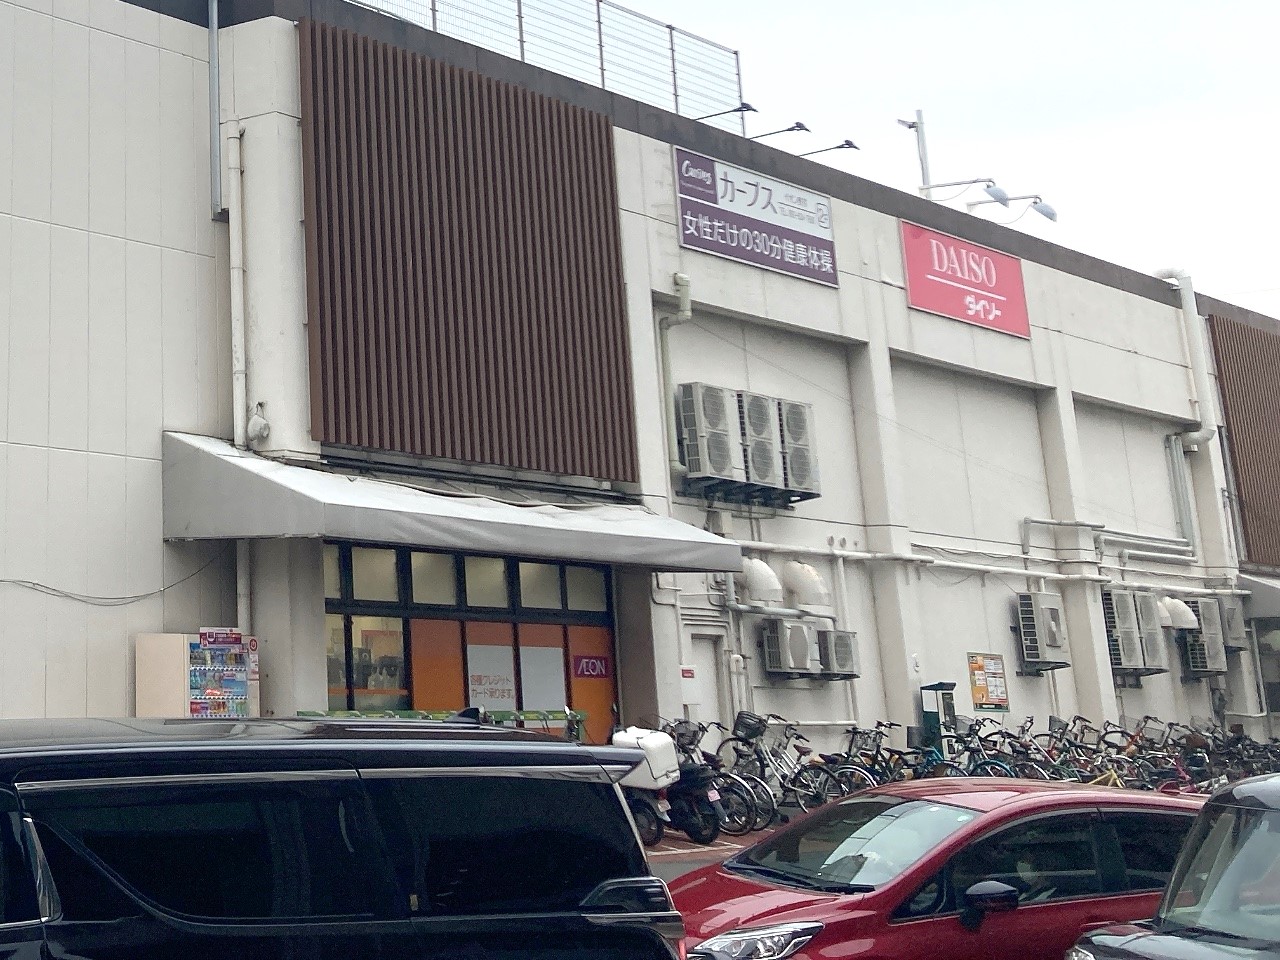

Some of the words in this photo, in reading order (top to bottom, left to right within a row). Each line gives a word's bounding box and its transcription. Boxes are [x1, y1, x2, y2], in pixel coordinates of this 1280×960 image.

[682, 210, 834, 274] 女性だけの30分健康体操
[930, 239, 998, 289] DAISO
[965, 294, 1002, 321] ダイソー
